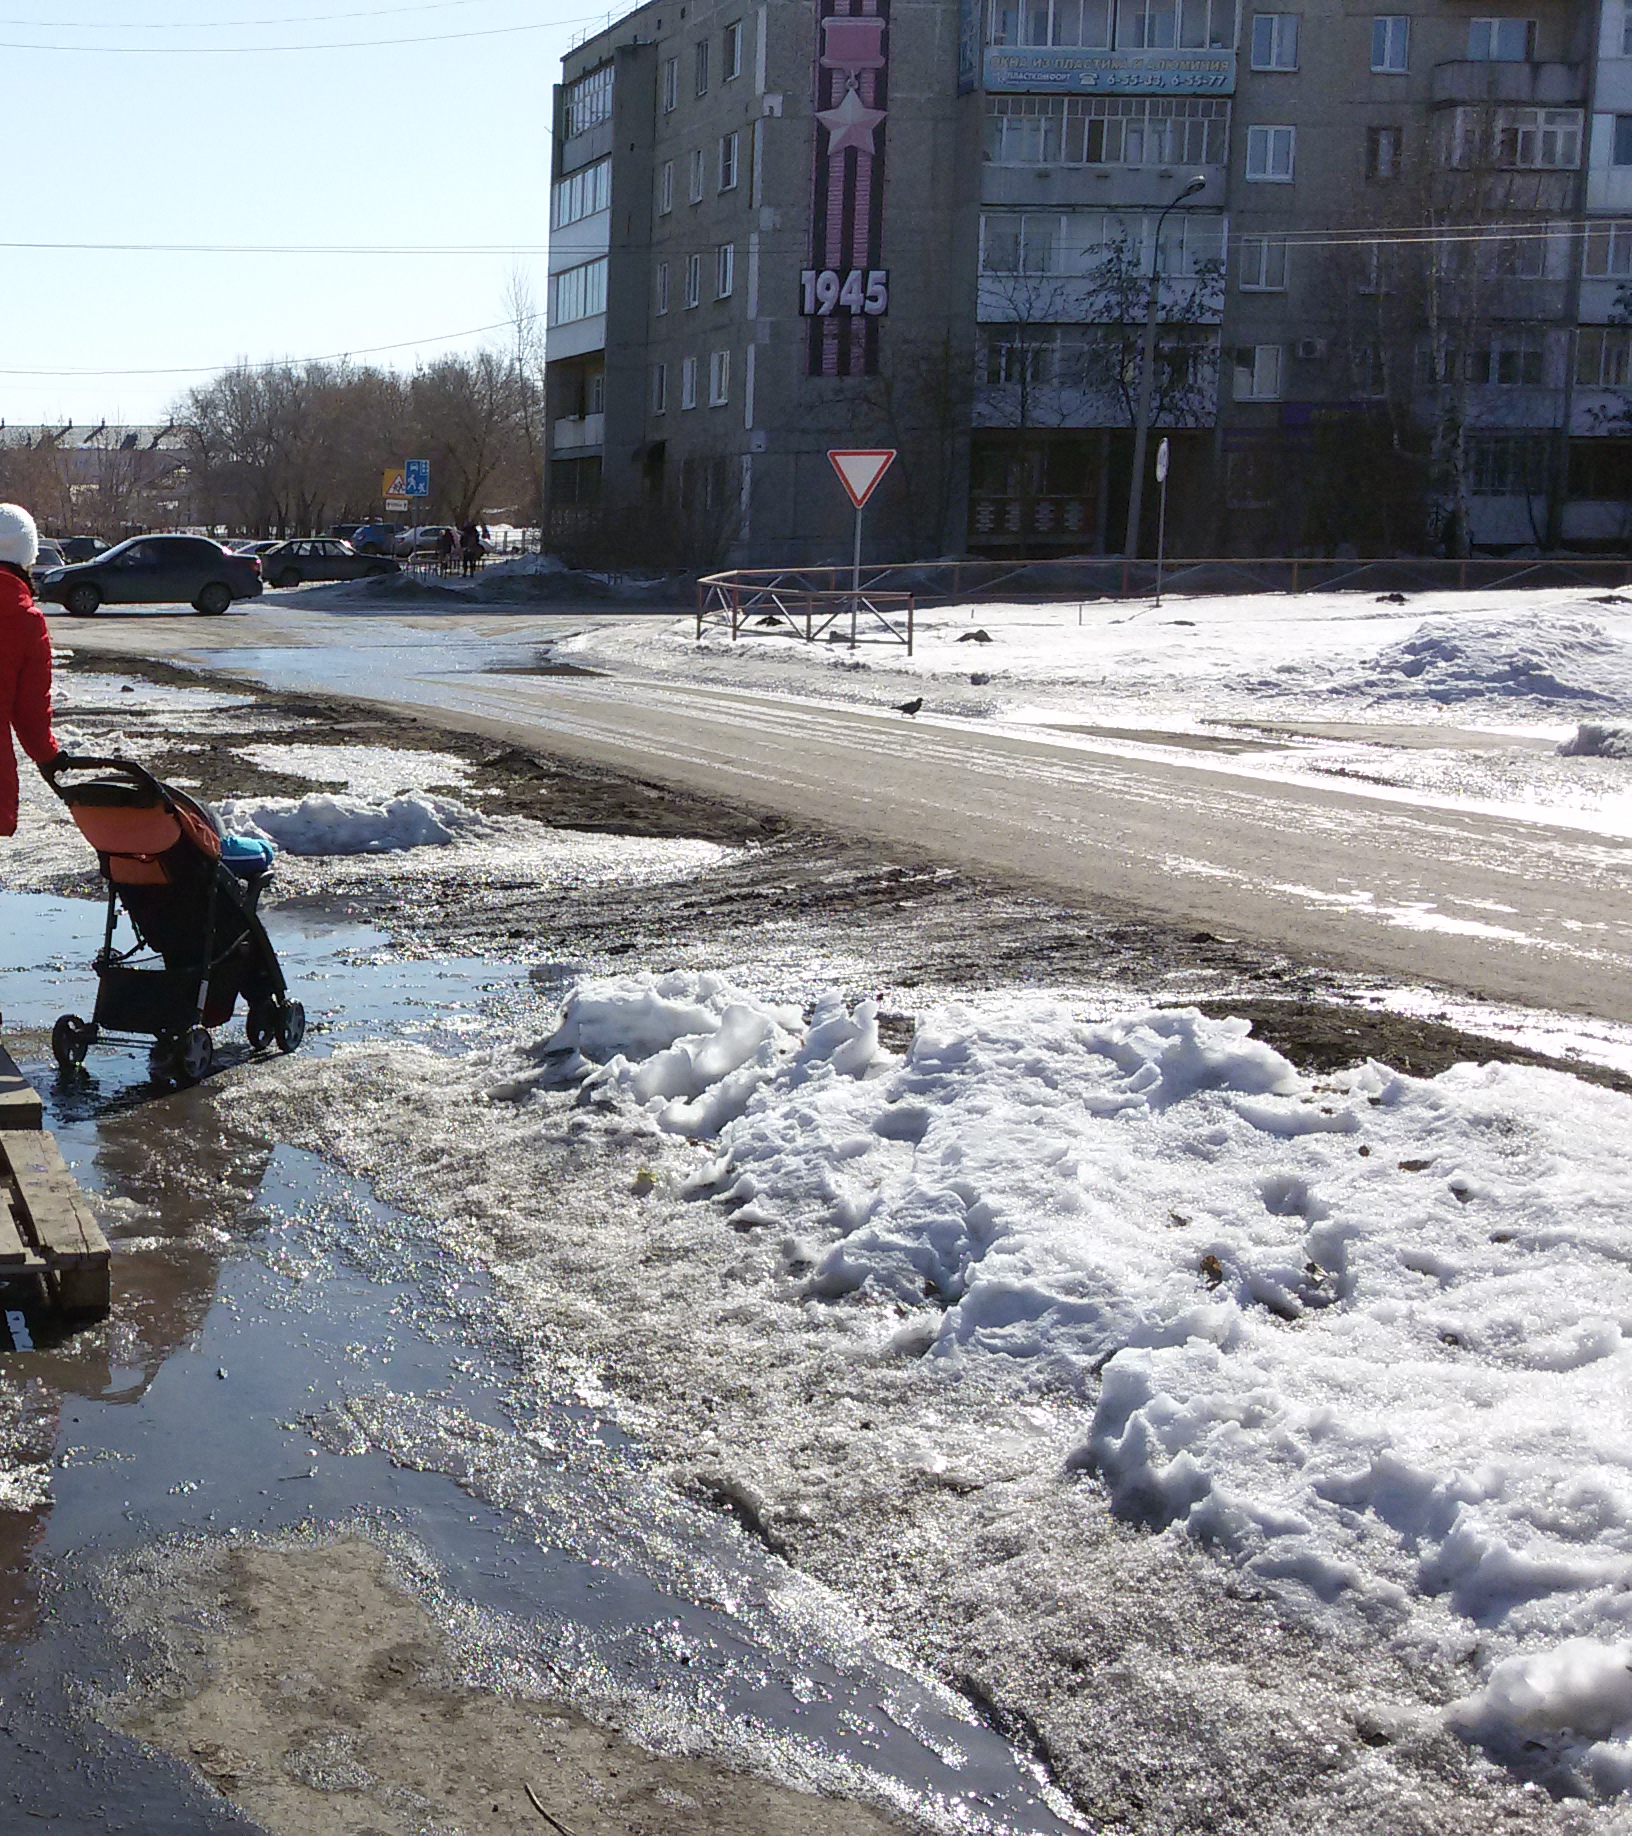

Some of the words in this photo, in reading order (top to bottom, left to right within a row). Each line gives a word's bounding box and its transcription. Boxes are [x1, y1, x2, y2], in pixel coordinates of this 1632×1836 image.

[990, 56, 1027, 69] ОКНА
[1032, 57, 1050, 70] ИЗ
[1054, 57, 1128, 71] ПЛАСТИКА
[1132, 58, 1144, 71] И
[1147, 59, 1229, 72] АЛЮМИНИЯ
[801, 270, 888, 315] 1945
